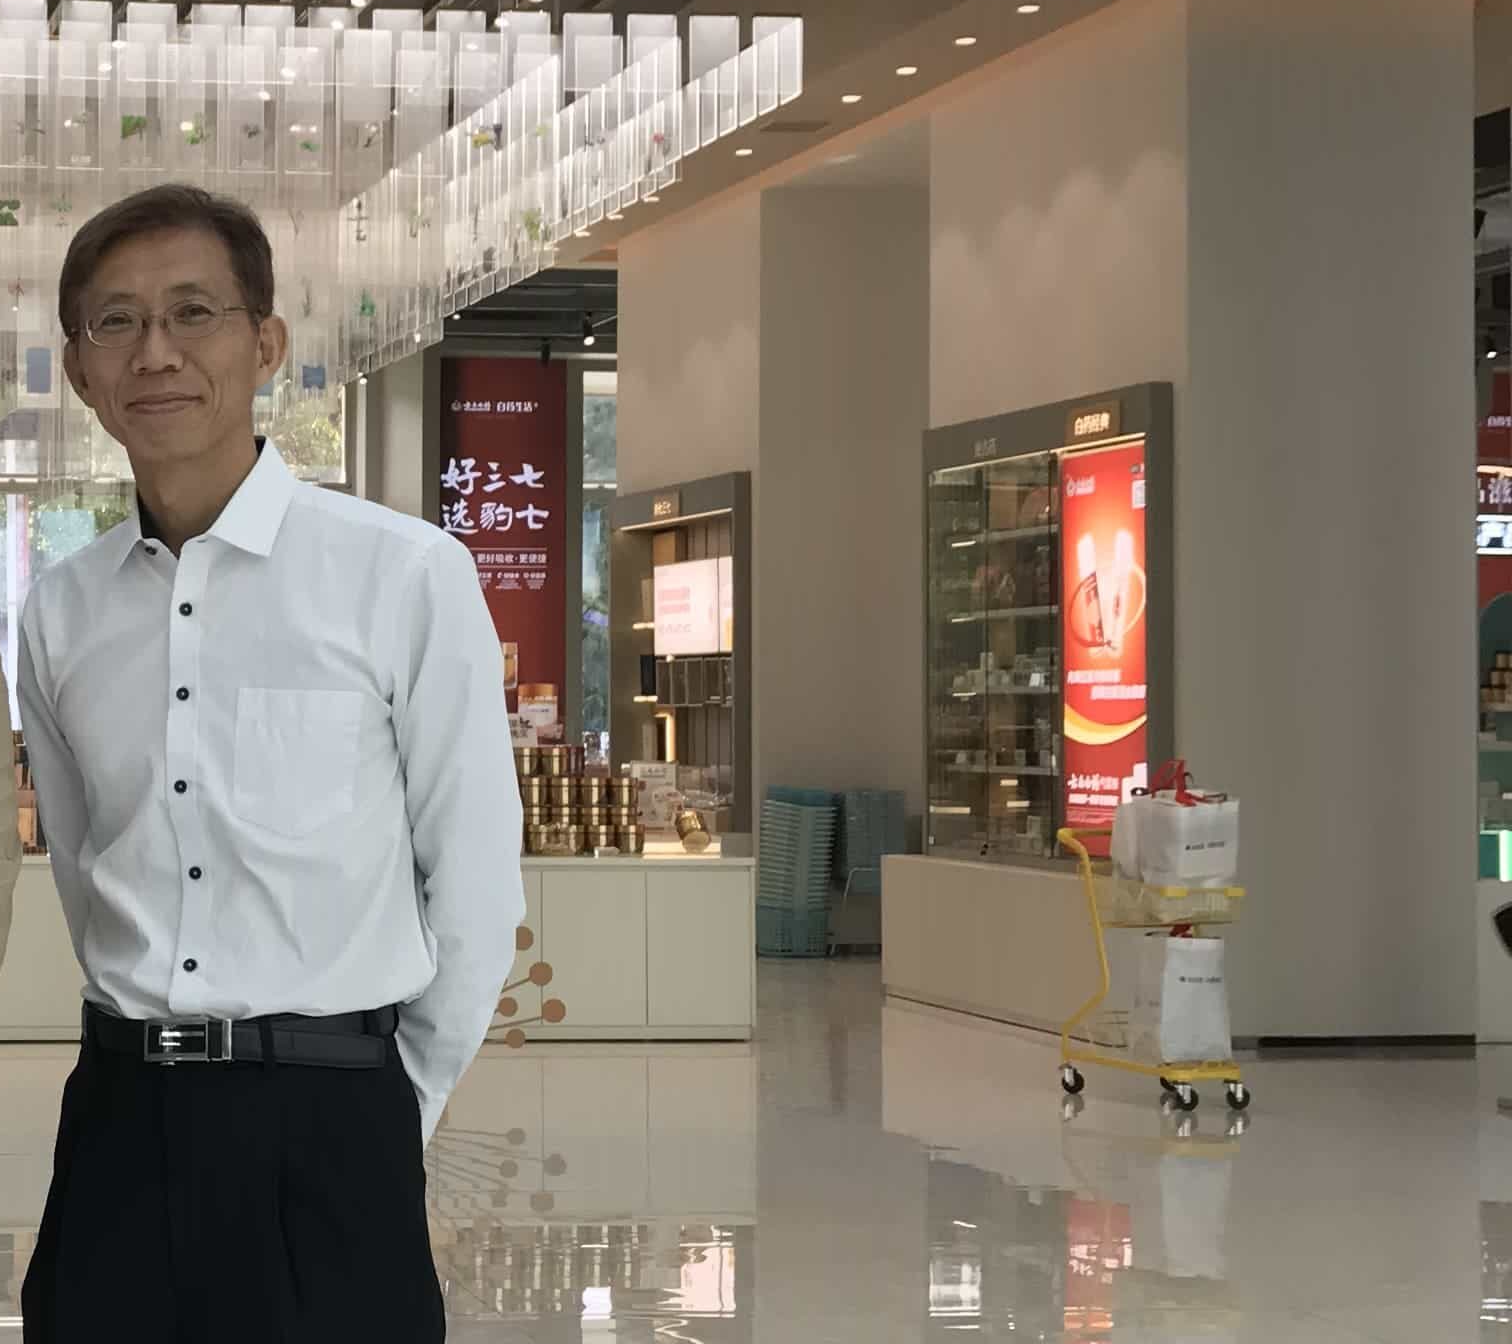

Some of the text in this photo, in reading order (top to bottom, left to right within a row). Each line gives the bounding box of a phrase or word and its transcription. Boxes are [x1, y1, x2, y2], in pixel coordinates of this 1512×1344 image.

[440, 457, 545, 495] 好三七
[442, 498, 550, 534] 选豹七
